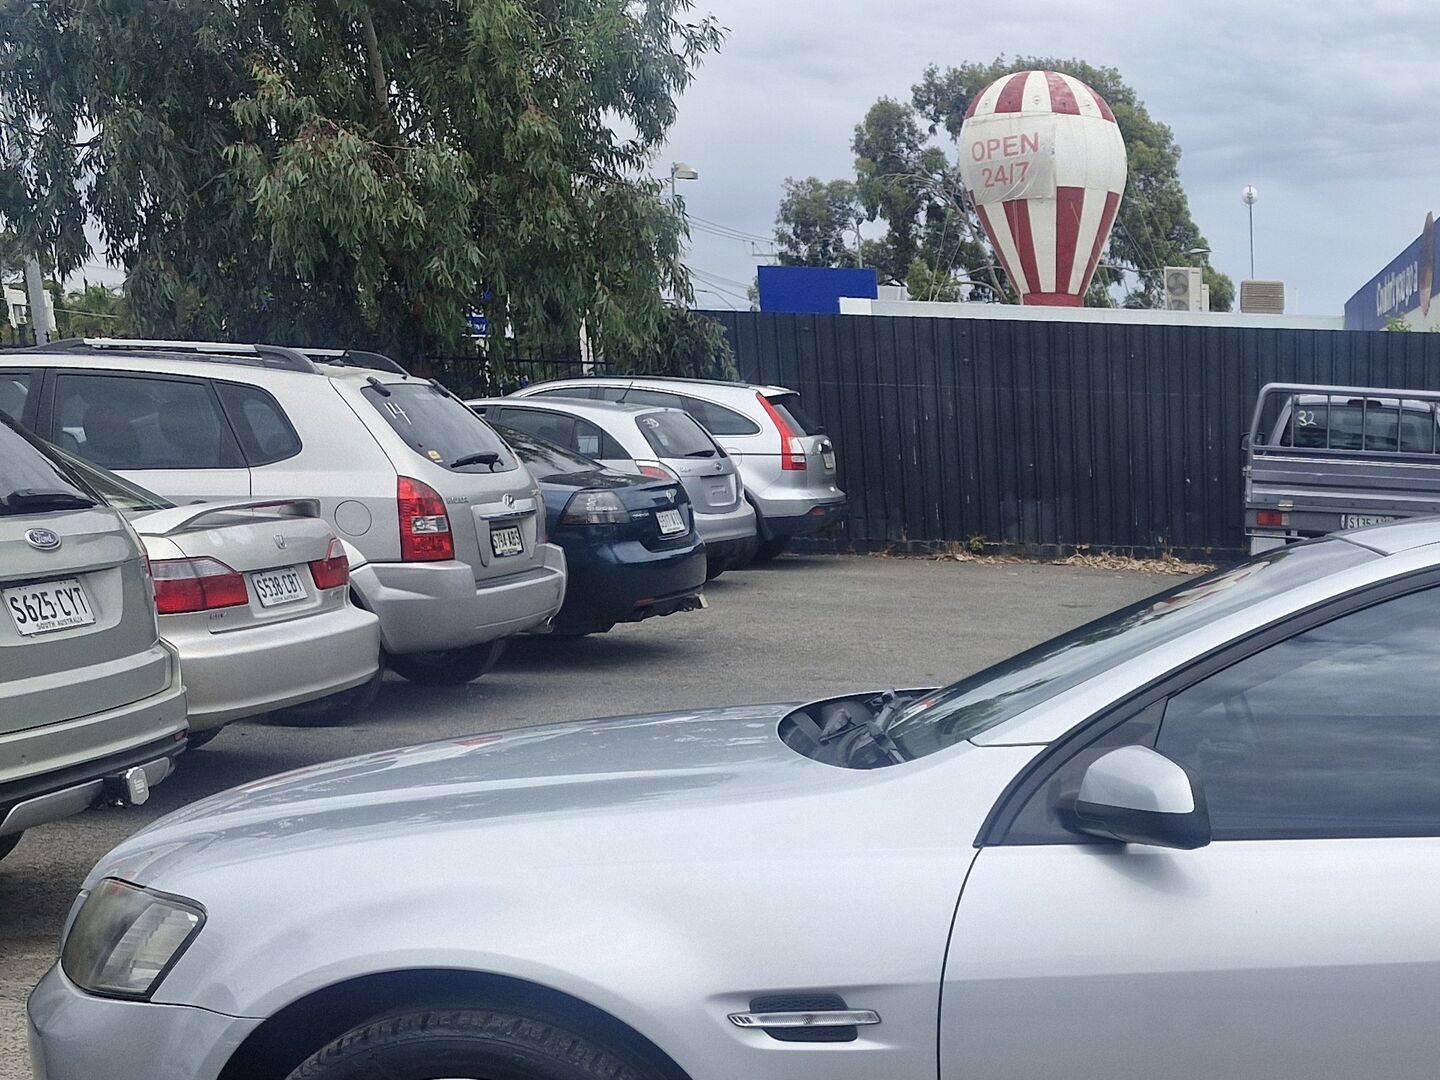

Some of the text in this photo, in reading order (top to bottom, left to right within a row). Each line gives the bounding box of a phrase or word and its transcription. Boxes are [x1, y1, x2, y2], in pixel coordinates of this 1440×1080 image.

[971, 132, 1039, 162] OPEN
[982, 161, 1029, 188] 24/7
[1298, 410, 1317, 427] 32
[36, 616, 84, 630] SOUTH AUSTRALIA
